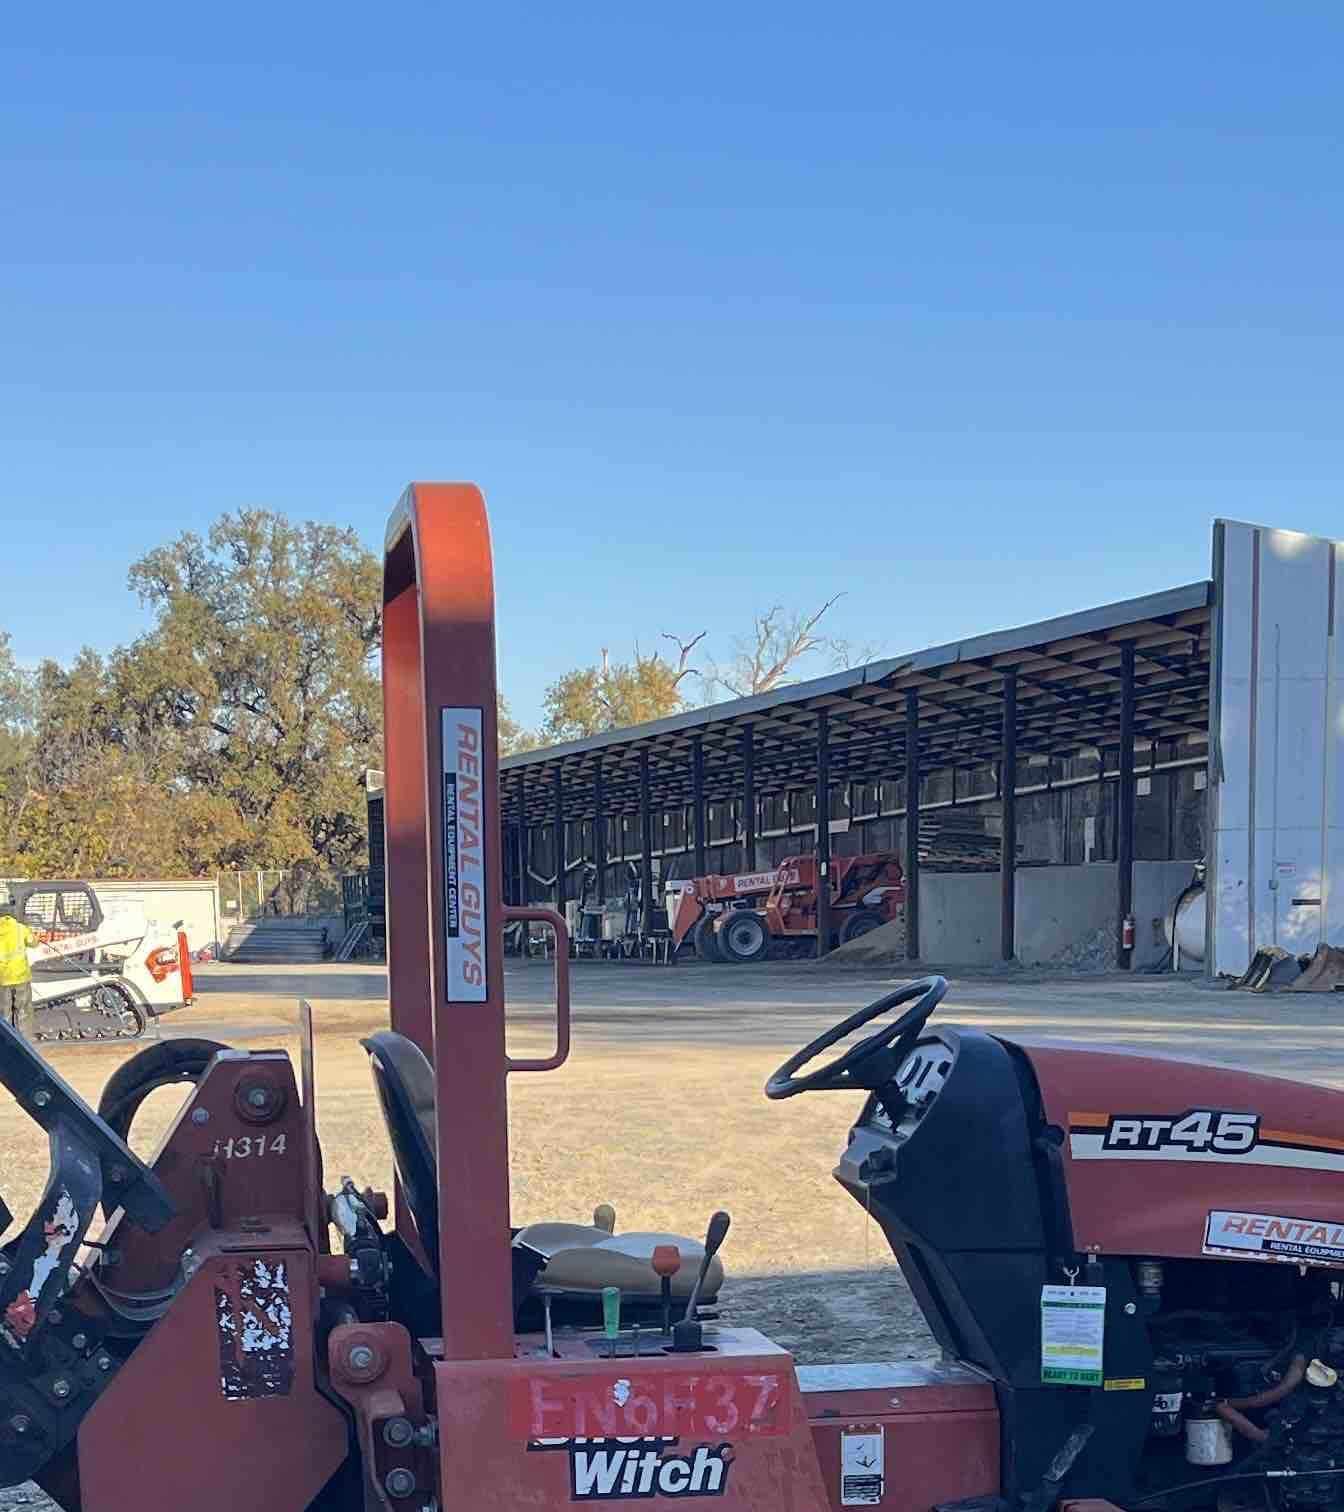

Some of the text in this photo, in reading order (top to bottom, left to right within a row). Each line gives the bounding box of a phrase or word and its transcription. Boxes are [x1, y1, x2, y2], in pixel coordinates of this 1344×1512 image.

[447, 783, 457, 823] RENTAL
[457, 722, 483, 987] RENTAL GUYS
[1109, 1112, 1256, 1150] RT45
[1222, 1215, 1344, 1246] RENTAL
[1270, 1241, 1303, 1253] RENTAL
[573, 1447, 724, 1495] Witch
